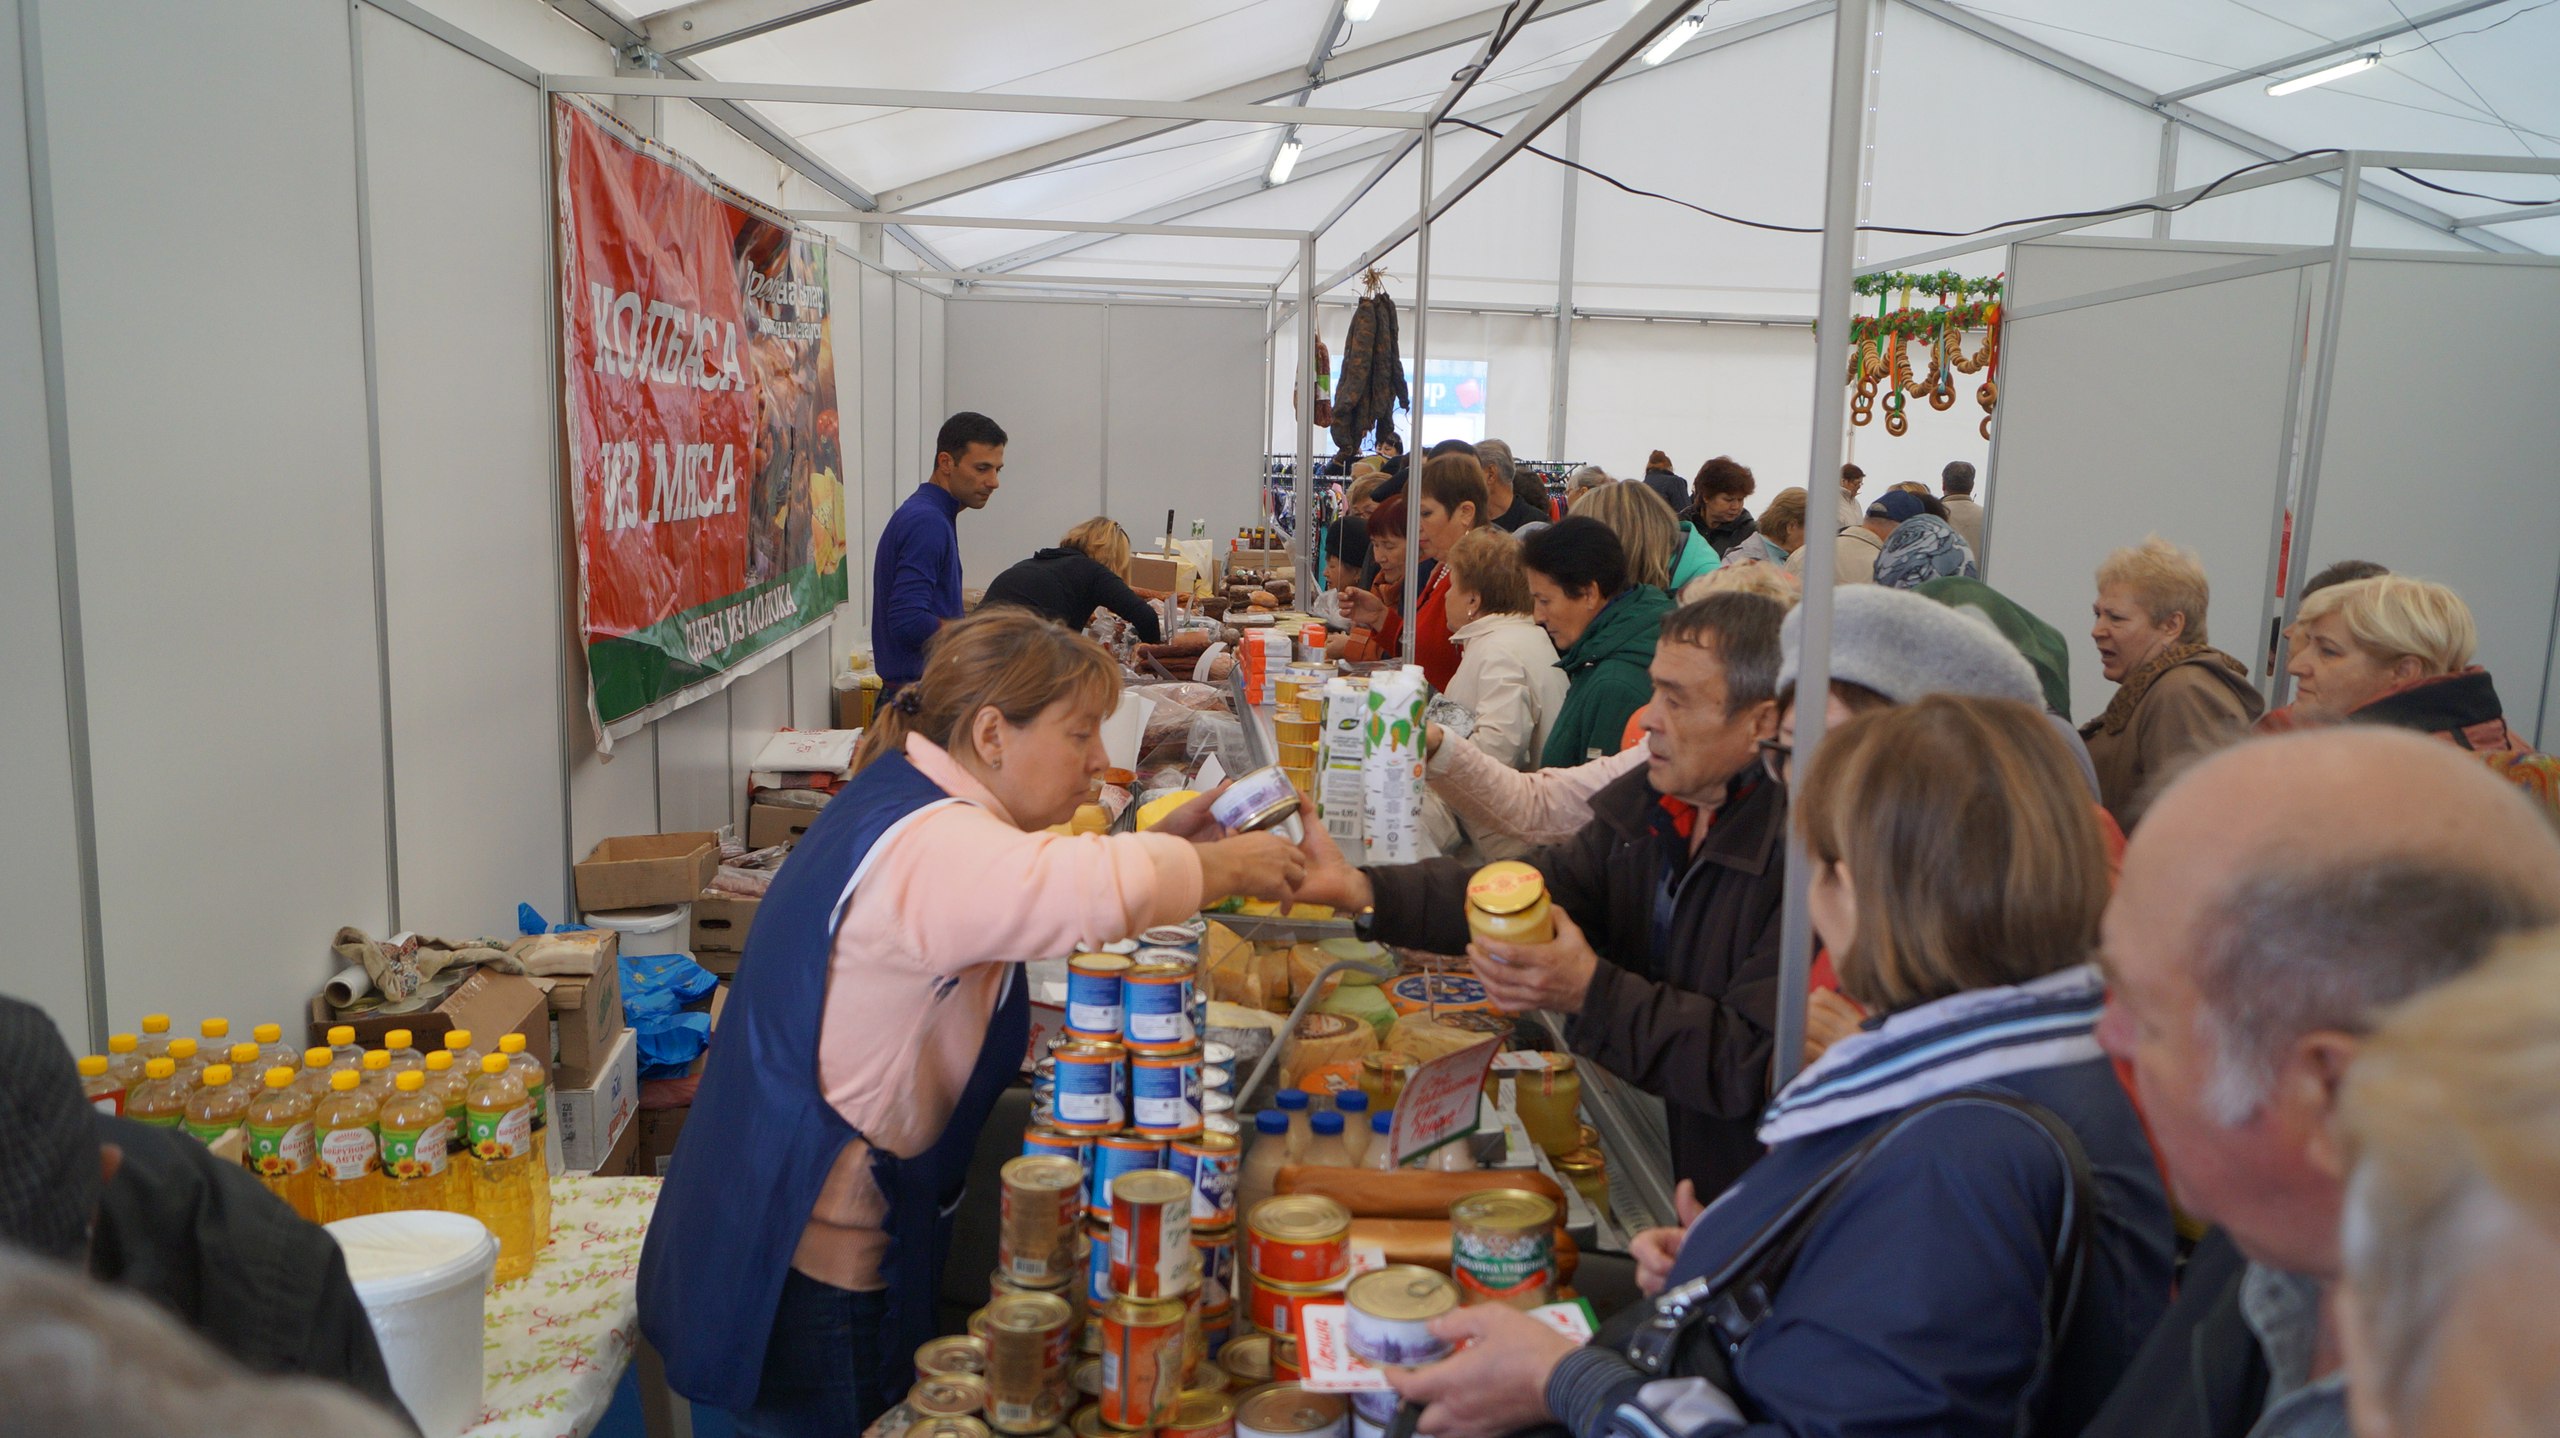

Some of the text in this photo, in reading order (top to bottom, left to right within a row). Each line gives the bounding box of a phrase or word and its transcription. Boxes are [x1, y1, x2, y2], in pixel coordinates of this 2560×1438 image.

[591, 282, 744, 392] КОЛБАСА
[601, 440, 737, 531] ИЗ МЯСА
[686, 583, 798, 663] СЫРЫ ИЗ МОЛОКА
